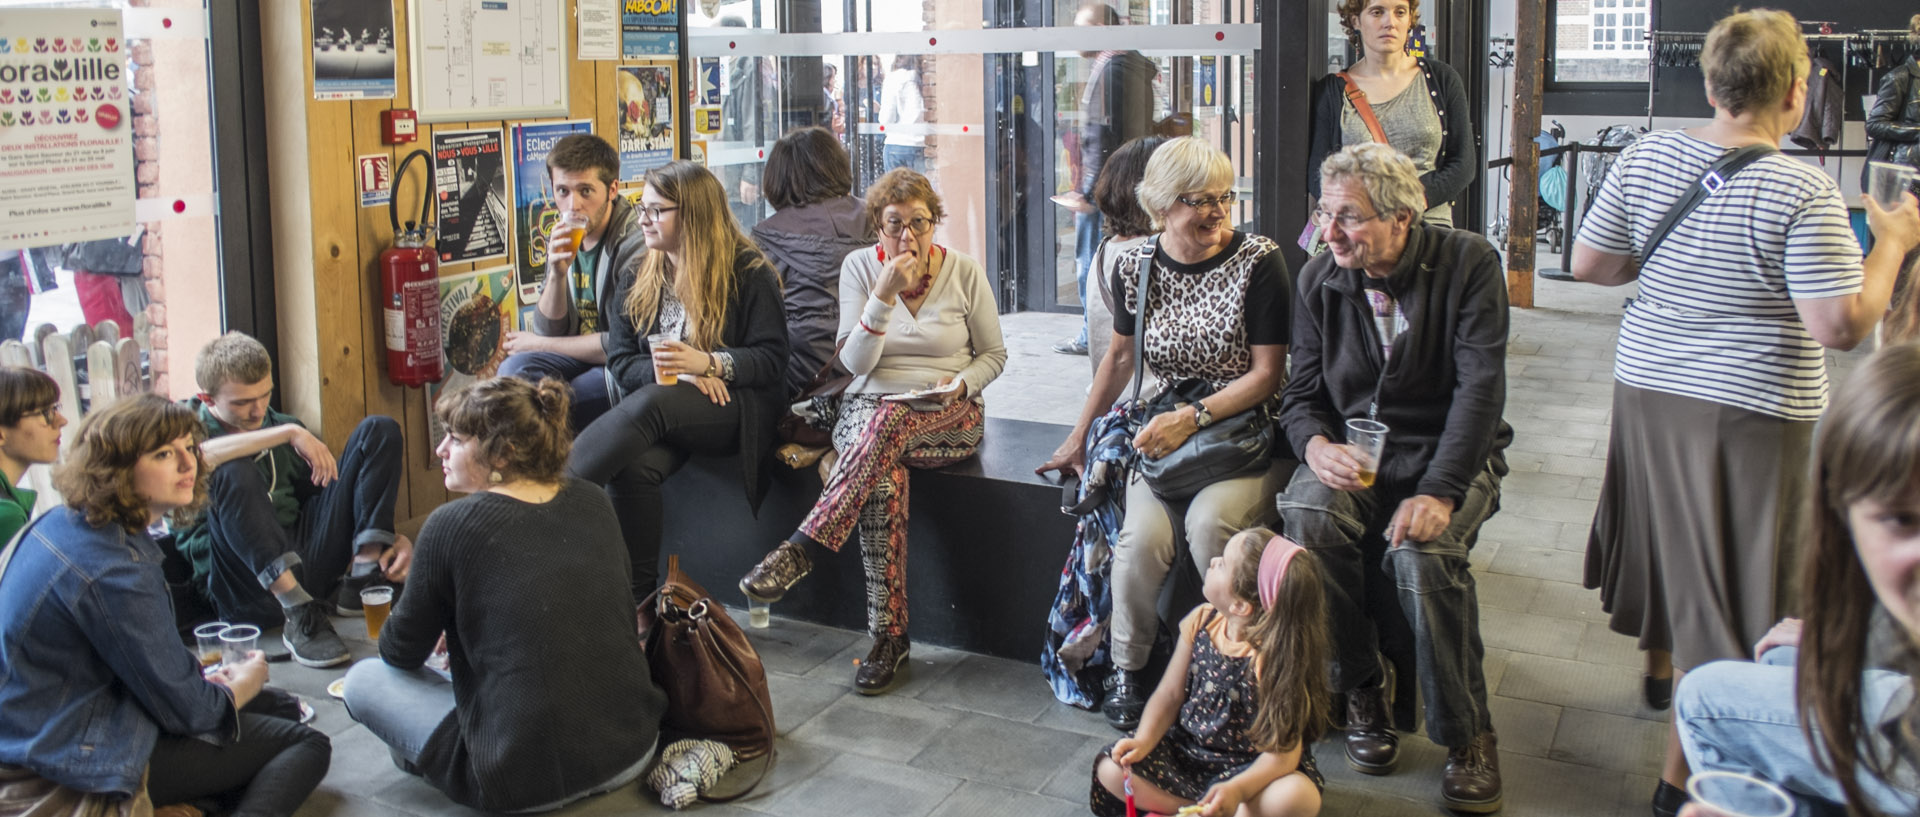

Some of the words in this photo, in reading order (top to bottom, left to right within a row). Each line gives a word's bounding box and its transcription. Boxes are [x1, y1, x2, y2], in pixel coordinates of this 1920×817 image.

[24, 139, 78, 150] INSTALLATIONS
[437, 149, 456, 160] NOUS
[461, 145, 478, 156] VOUS
[482, 143, 499, 153] LILLE
[621, 137, 648, 153] DARK
[649, 135, 673, 151] STAR
